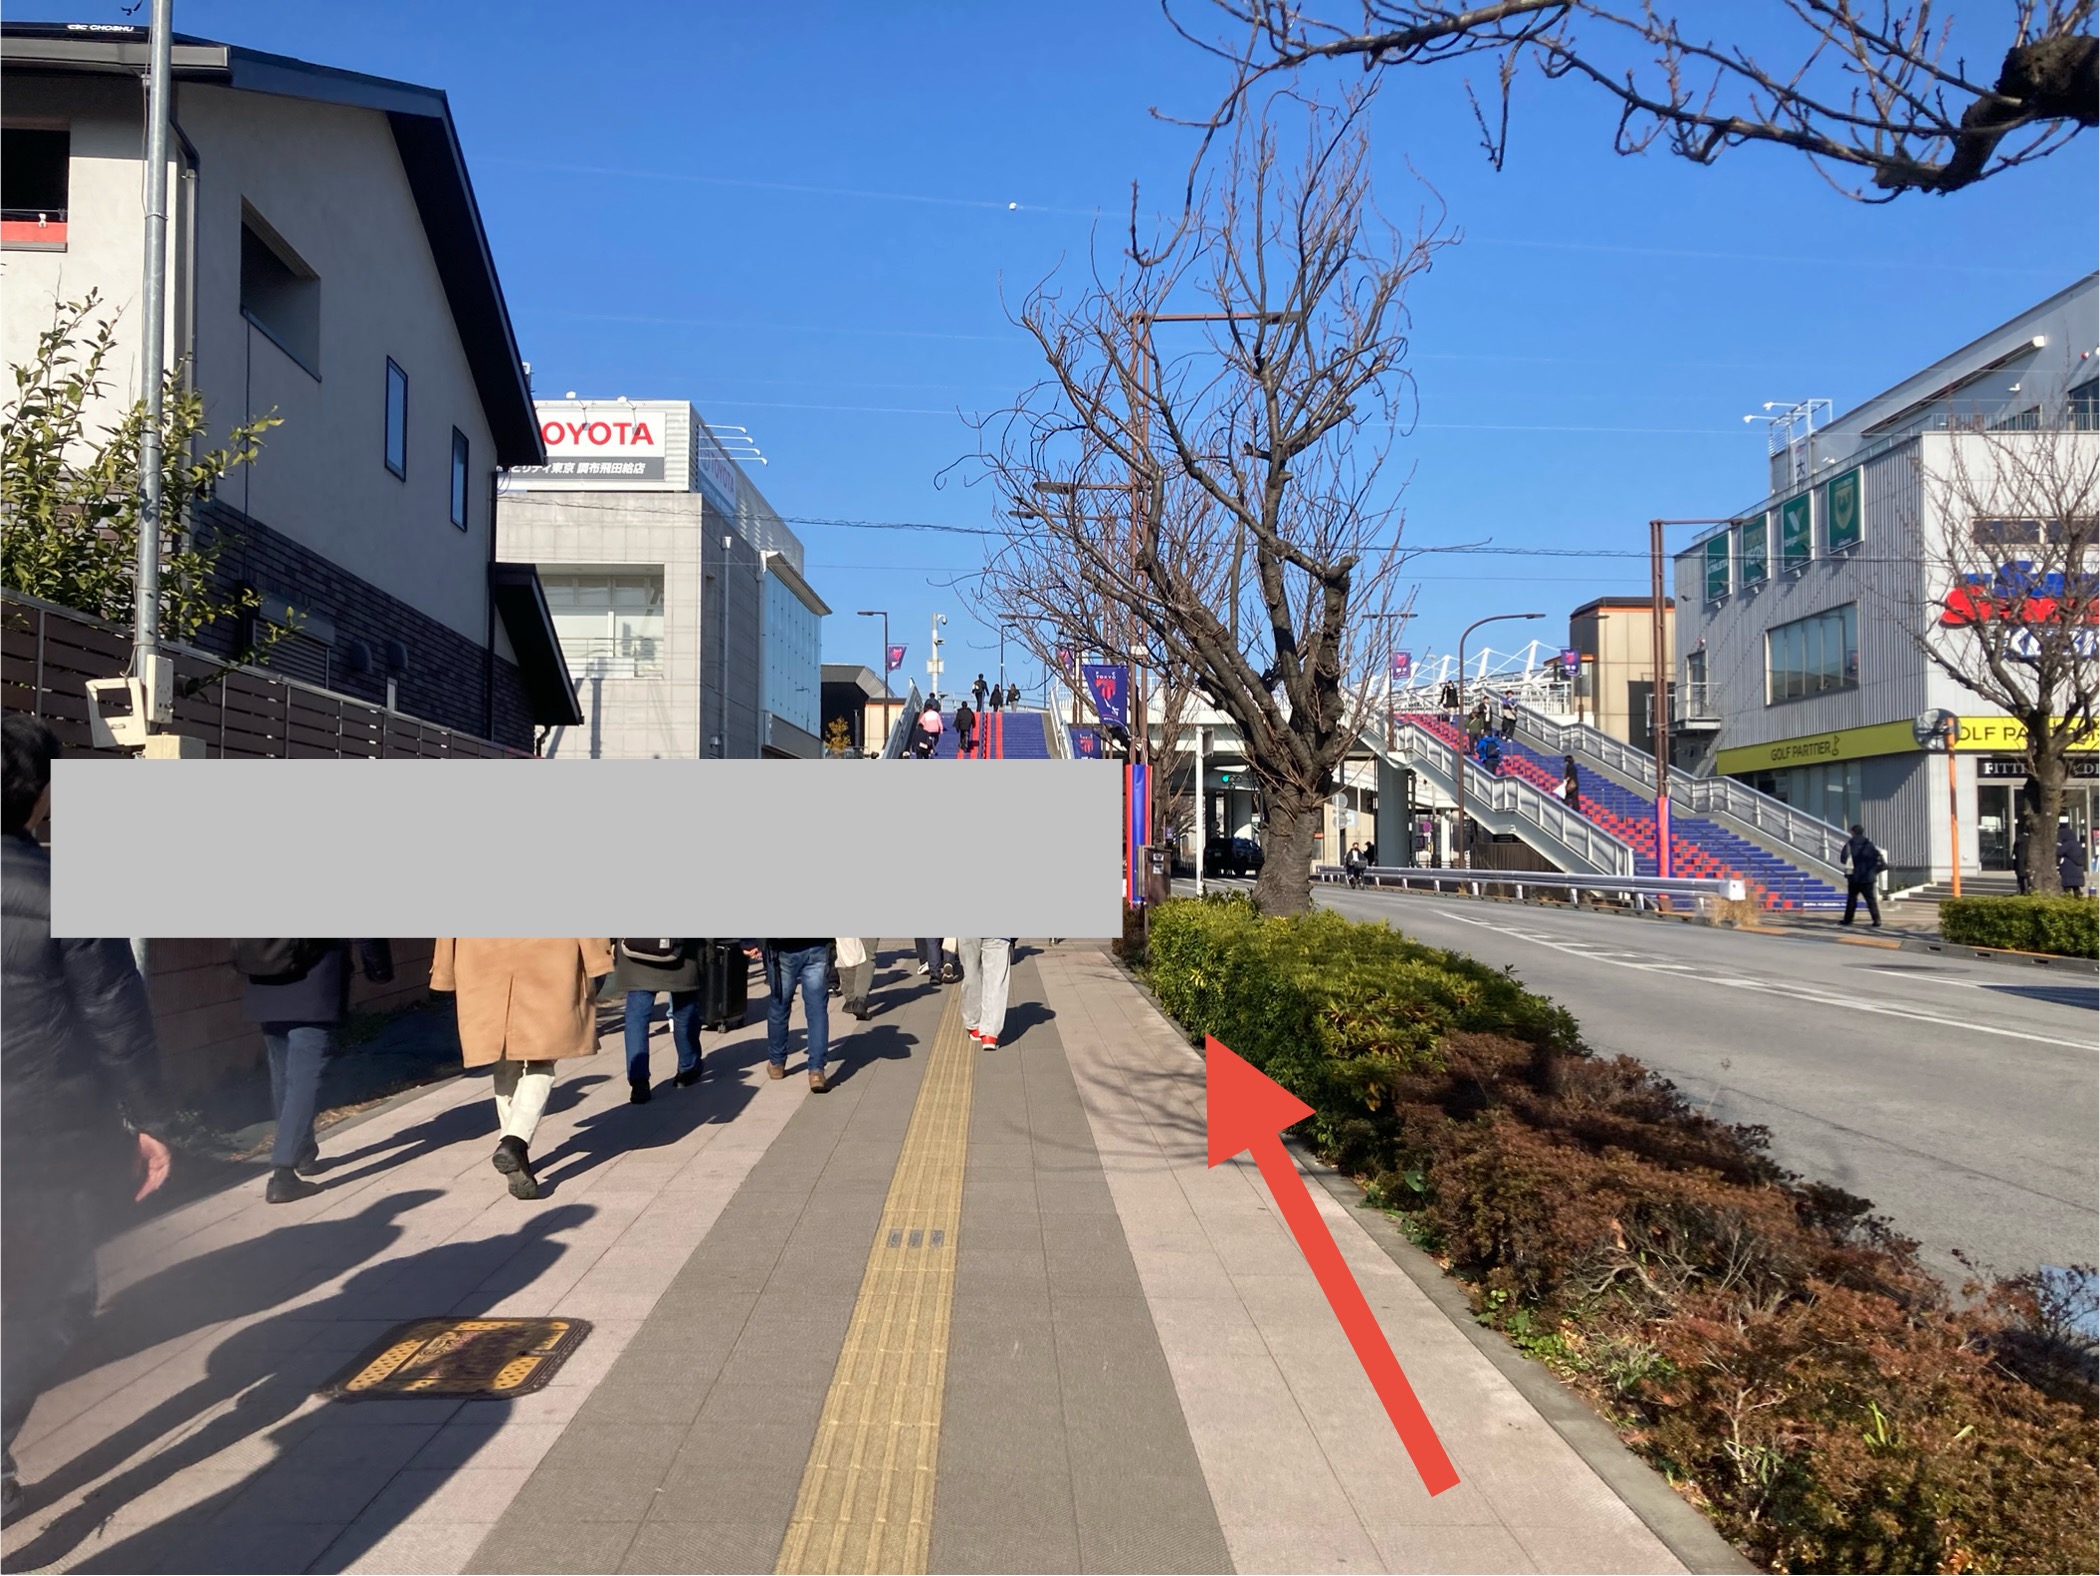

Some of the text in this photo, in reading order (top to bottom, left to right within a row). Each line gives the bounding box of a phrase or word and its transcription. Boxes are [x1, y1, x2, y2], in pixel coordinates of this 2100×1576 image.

[542, 421, 654, 445] OYOTA
[1959, 727, 1996, 741] OLF
[1771, 746, 1791, 761] GOLF
